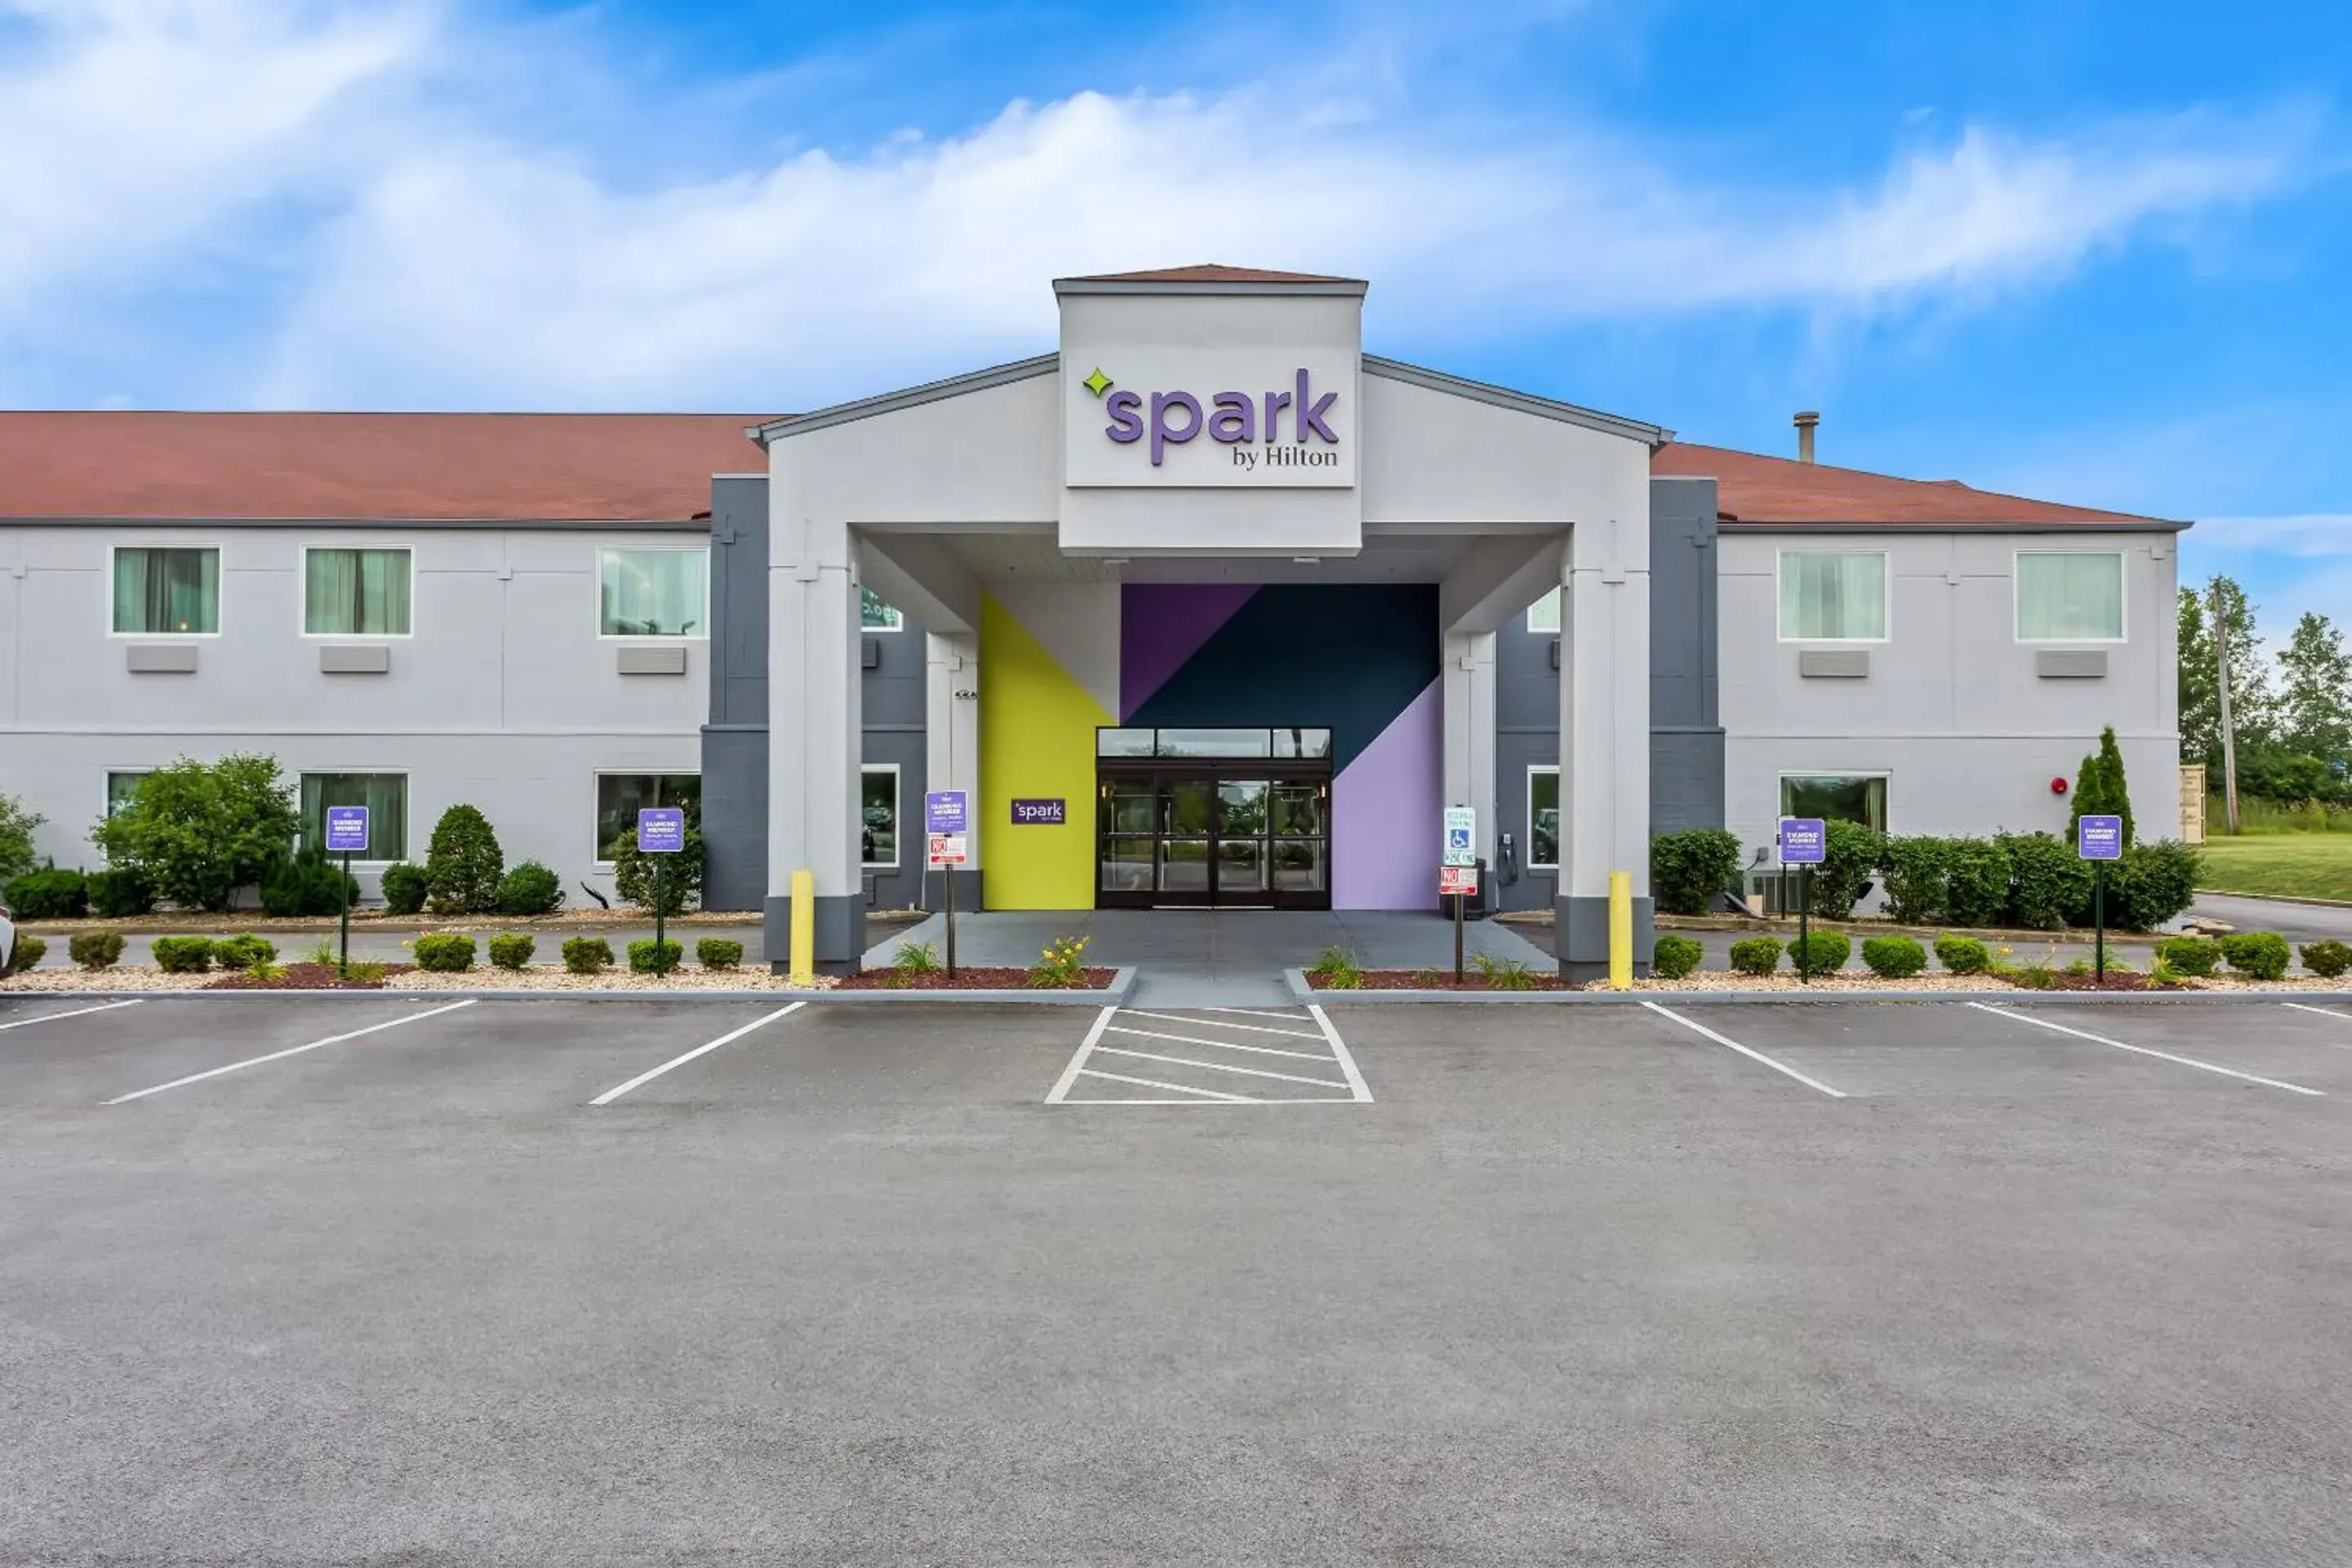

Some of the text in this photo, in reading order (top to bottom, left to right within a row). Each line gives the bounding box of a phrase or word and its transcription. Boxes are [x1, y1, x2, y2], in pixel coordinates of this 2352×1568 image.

[1105, 368, 1339, 466] spark
[1233, 446, 1338, 470] by Hilton
[1018, 802, 1062, 821] spark
